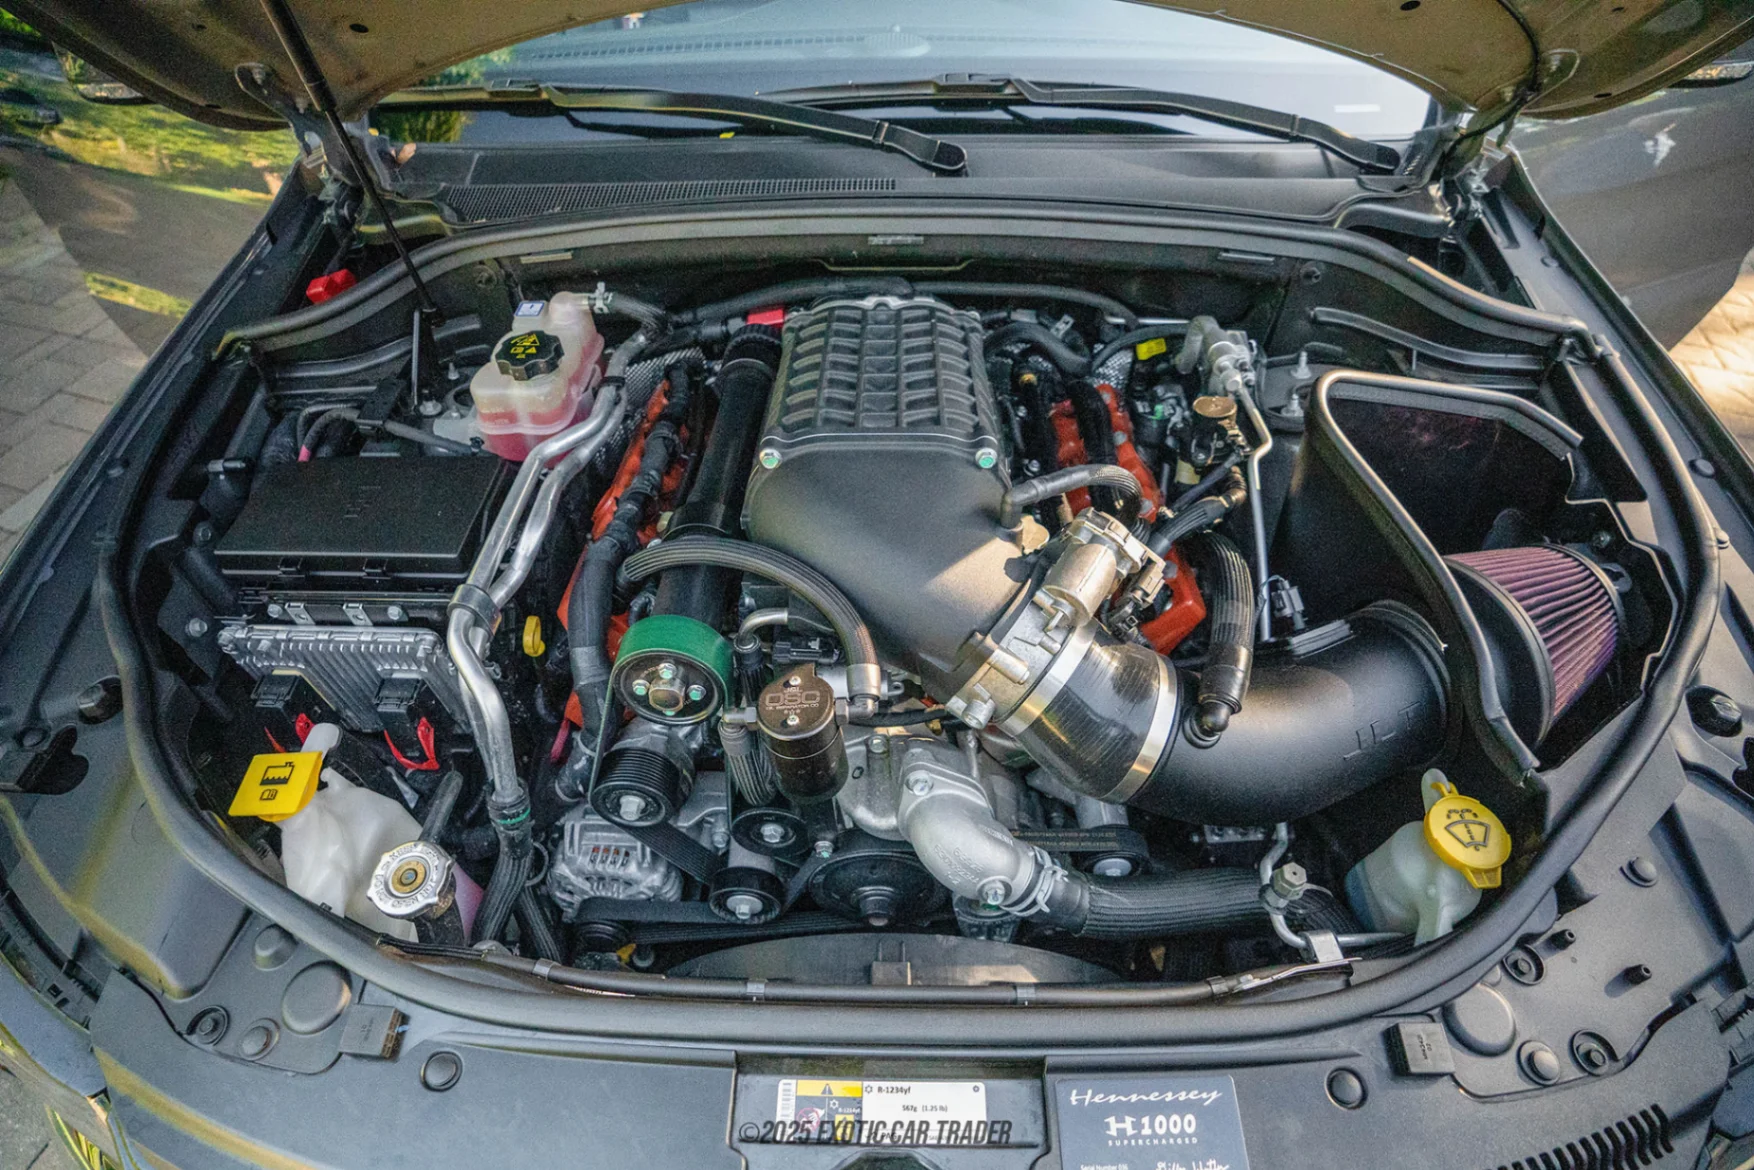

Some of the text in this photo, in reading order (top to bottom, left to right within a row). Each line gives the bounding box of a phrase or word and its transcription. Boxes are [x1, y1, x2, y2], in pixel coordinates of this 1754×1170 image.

[877, 1086, 911, 1095] R-1234yf
[1070, 1088, 1223, 1107] Hennessey
[1108, 1137, 1198, 1147] SUPERCHARGED
